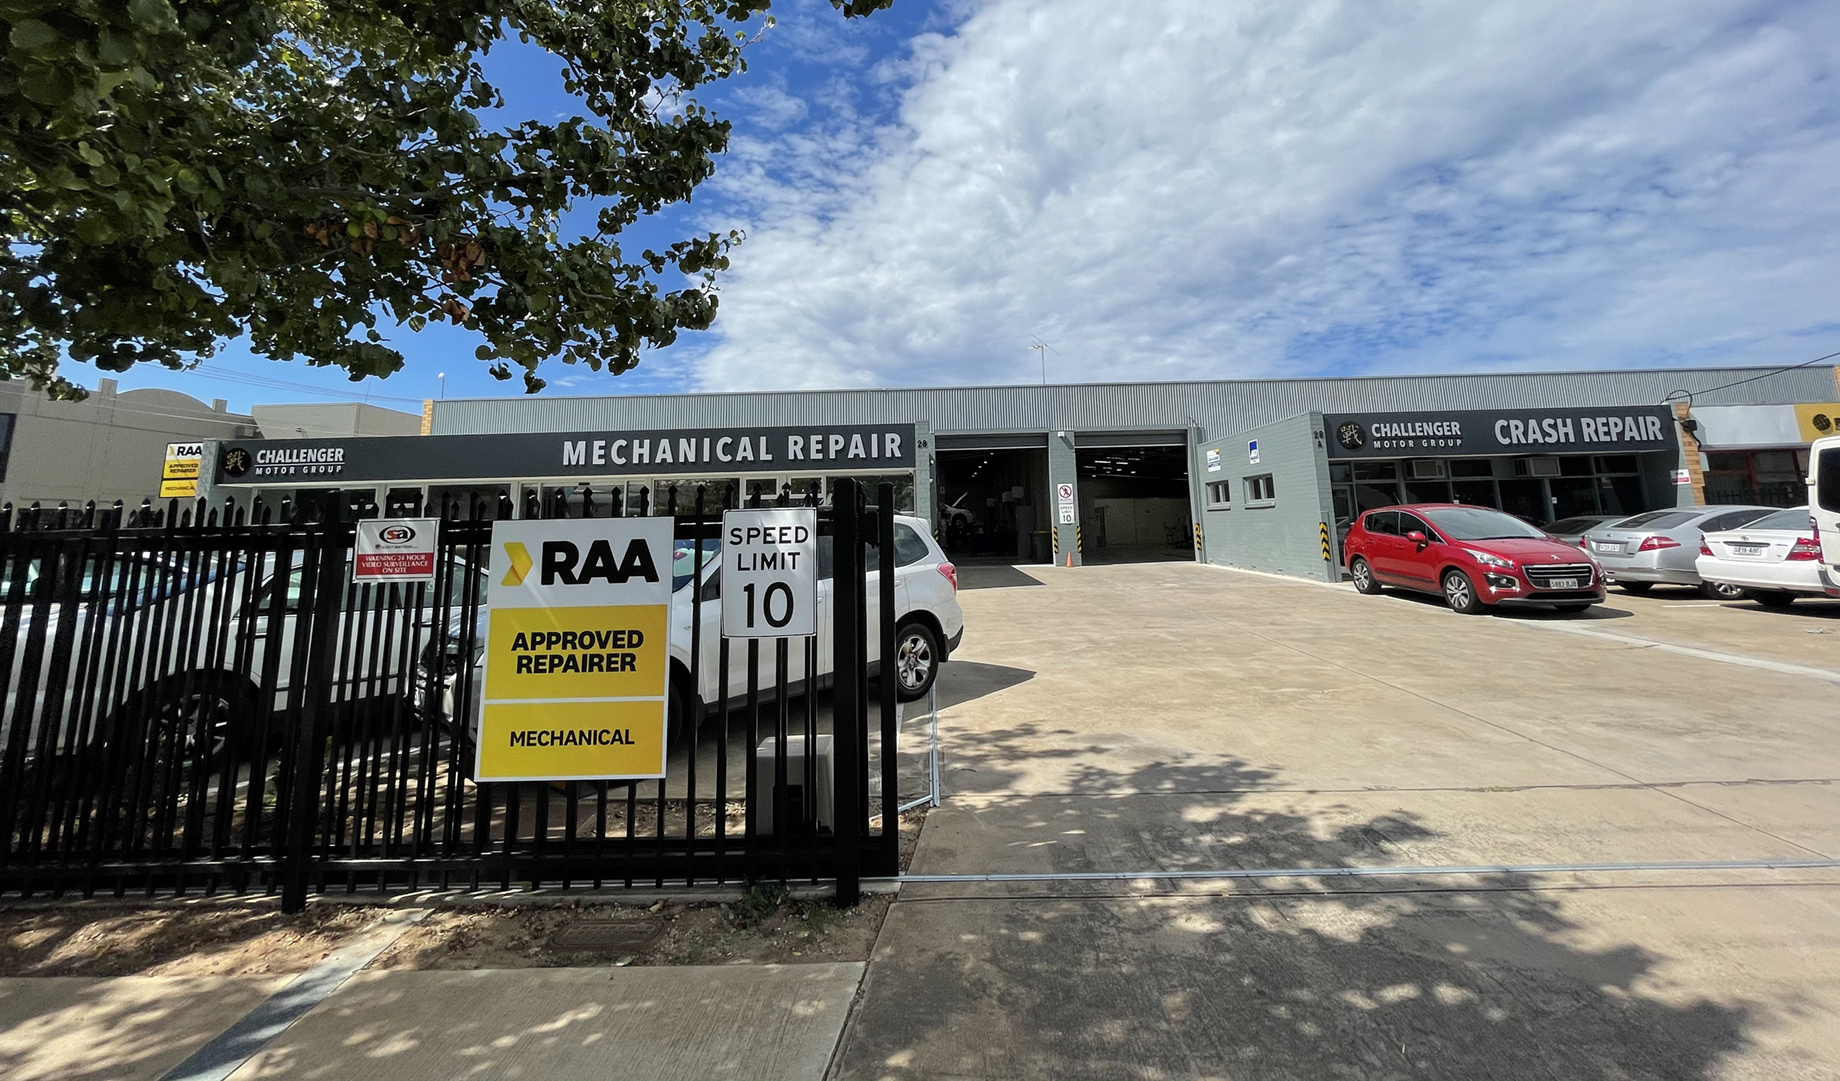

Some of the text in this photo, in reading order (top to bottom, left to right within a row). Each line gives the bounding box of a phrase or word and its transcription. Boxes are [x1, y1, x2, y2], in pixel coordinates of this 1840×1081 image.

[1371, 420, 1462, 438] CHALLENGER
[1494, 415, 1663, 445] CRASH REPAIR
[177, 446, 202, 456] RAA
[563, 432, 902, 466] MECHANICAL REPAIR
[1373, 437, 1464, 449] MOTOR GROUP
[256, 448, 345, 464] CHALLENGER
[255, 464, 342, 476] MOTOR GROUP
[730, 525, 809, 546] SPEED
[540, 538, 660, 586] RAA
[737, 551, 801, 572] LIMIT
[743, 581, 795, 629] 10
[511, 629, 644, 652] APPROVED
[516, 652, 637, 675] REPAIRER
[509, 728, 635, 748] MECHANICAL
